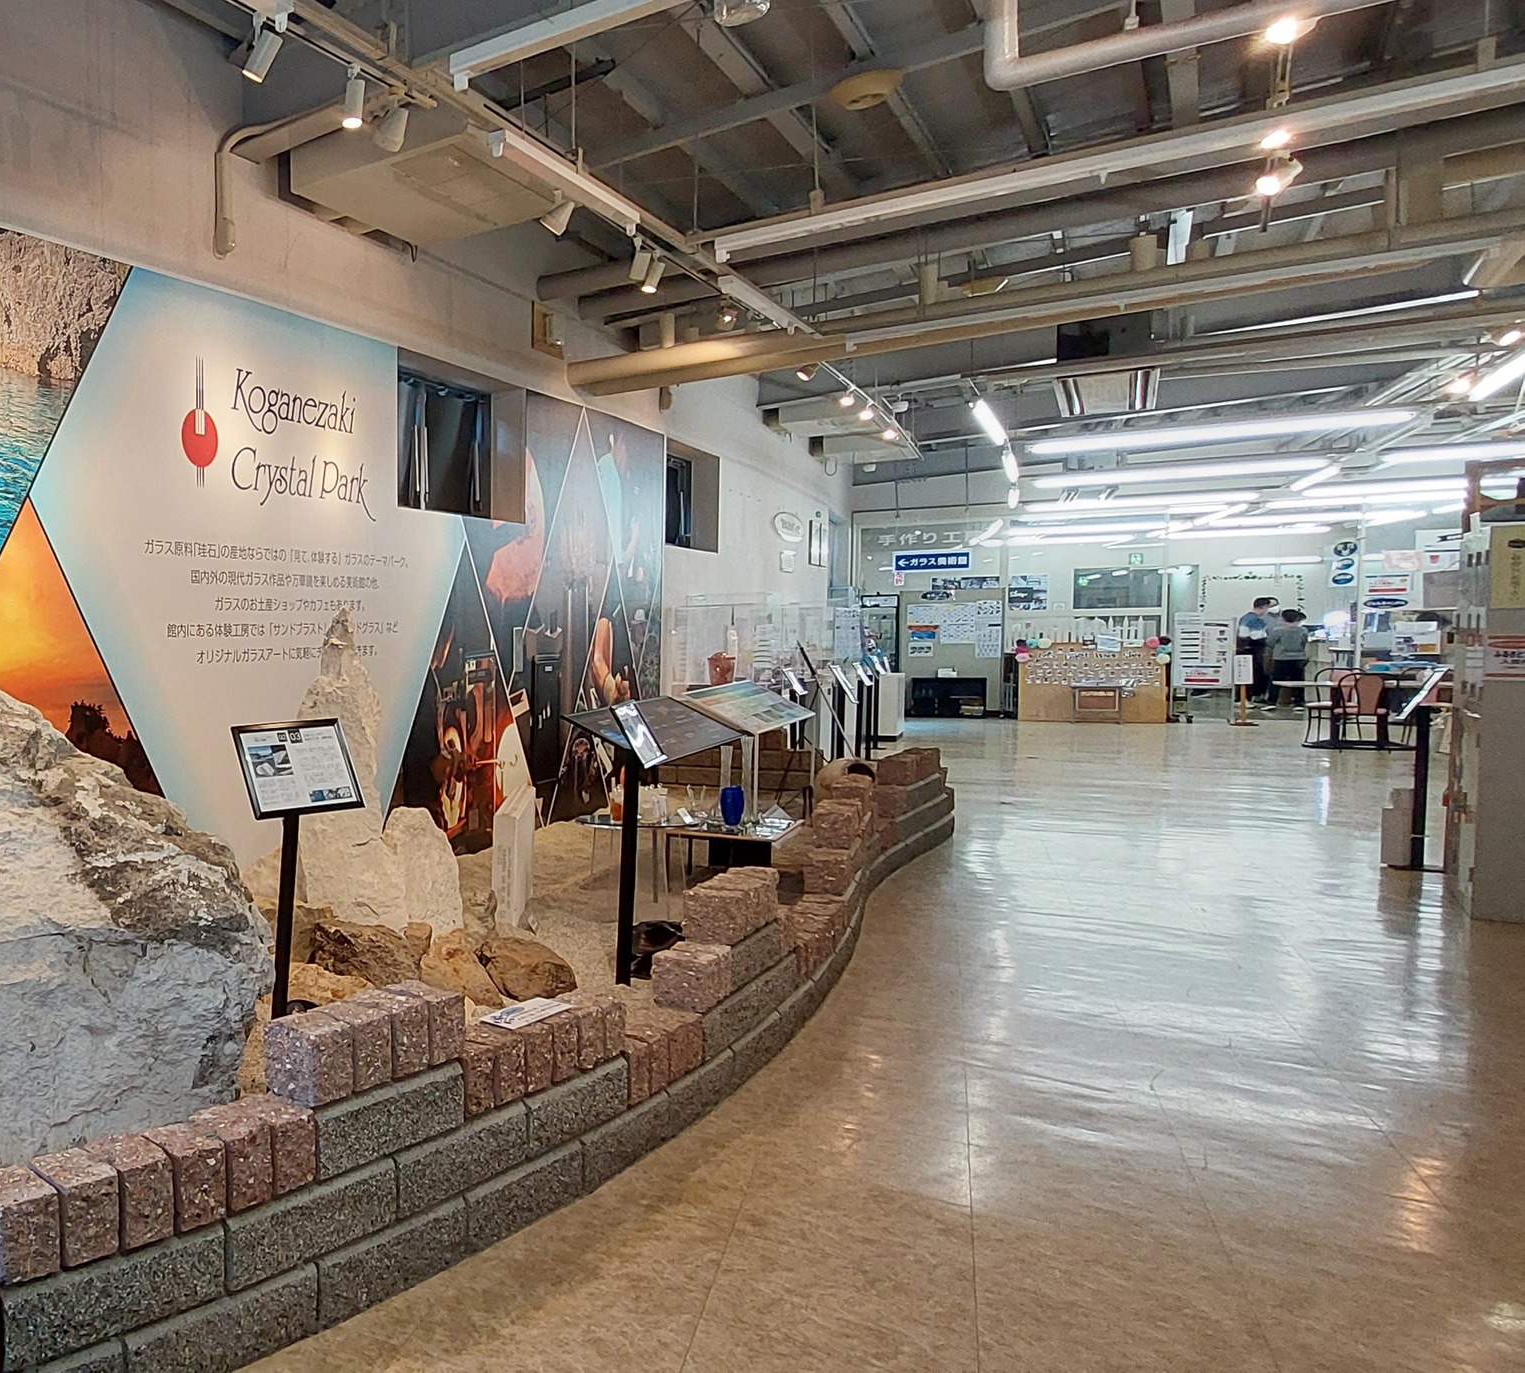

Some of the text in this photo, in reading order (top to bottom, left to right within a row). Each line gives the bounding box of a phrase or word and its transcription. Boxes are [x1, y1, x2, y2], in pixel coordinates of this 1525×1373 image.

[231, 368, 357, 434] Koganezaki
[231, 447, 377, 521] Crystal Park
[877, 529, 982, 547] 手作り工
[290, 731, 301, 741] 03
